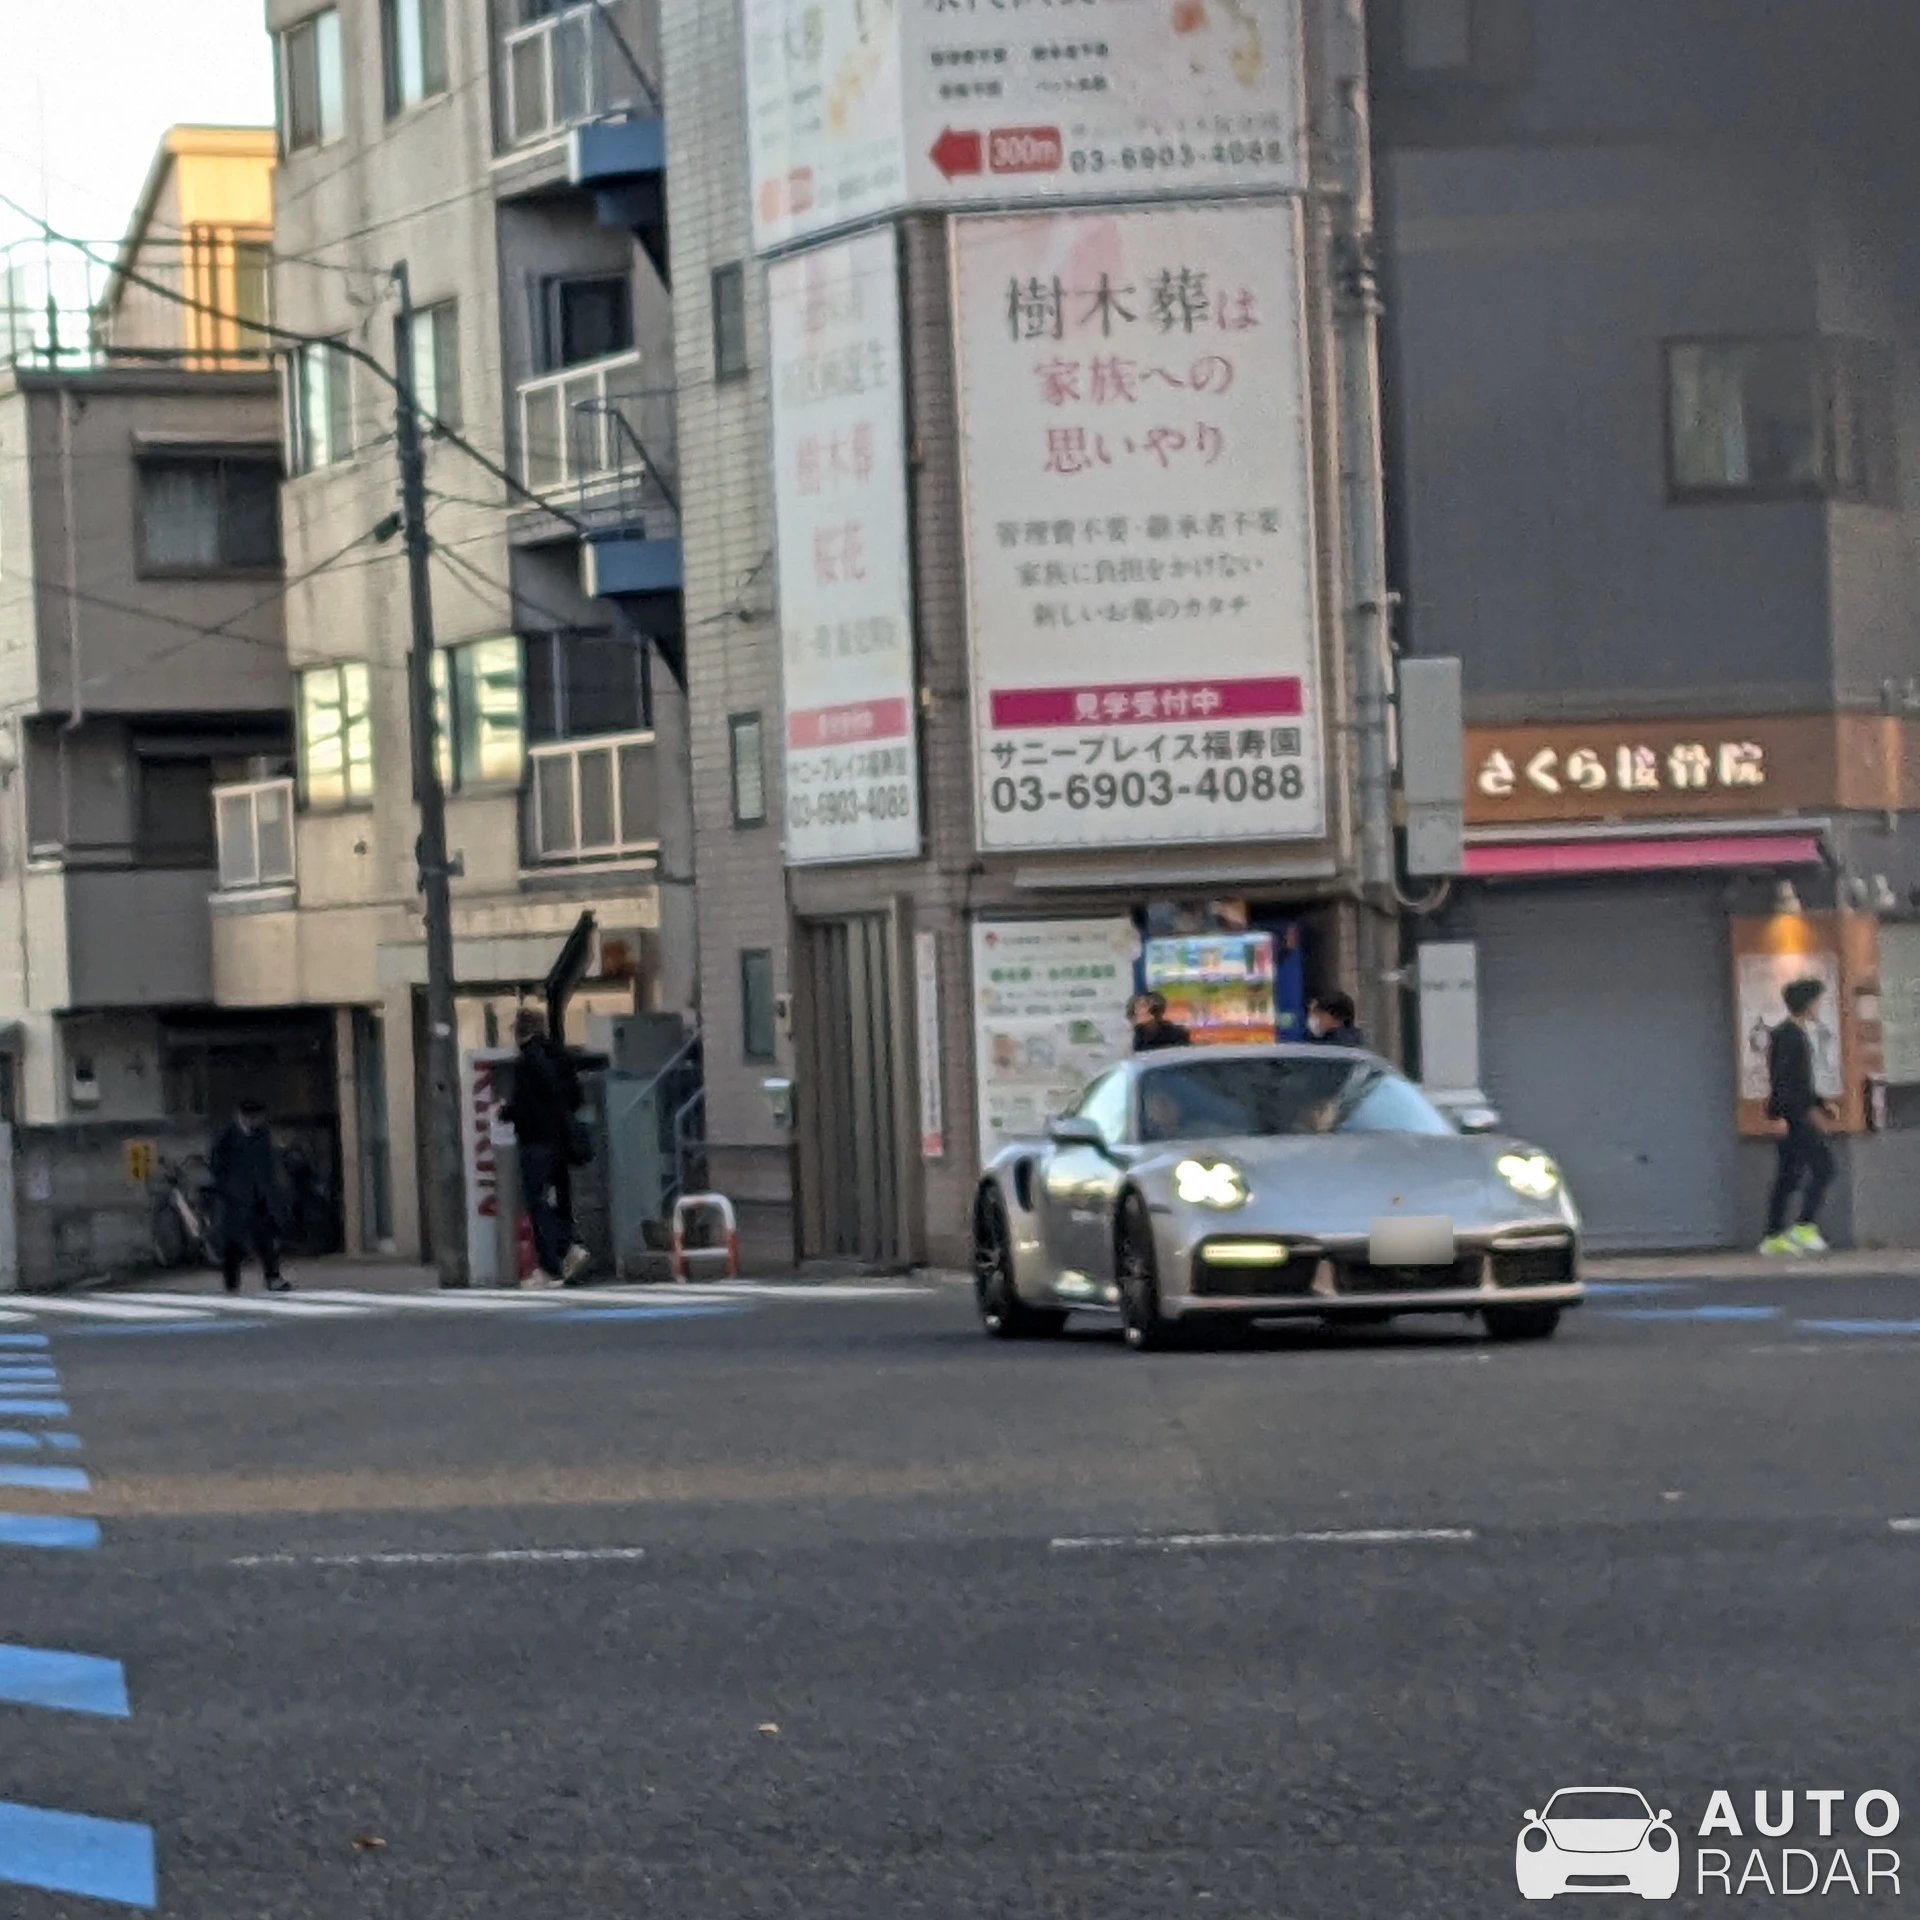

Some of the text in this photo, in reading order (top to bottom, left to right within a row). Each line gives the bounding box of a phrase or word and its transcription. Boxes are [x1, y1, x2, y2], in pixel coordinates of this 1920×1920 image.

[993, 137, 1060, 167] 300m
[1005, 266, 1258, 342] 樹木葬は
[1034, 355, 1234, 406] 家族への
[1044, 421, 1223, 473] 思いやり
[1074, 687, 1221, 721] 見学受付中
[991, 727, 1301, 770] サニープレイス福寿園
[992, 764, 1303, 813] 03-6903-4088
